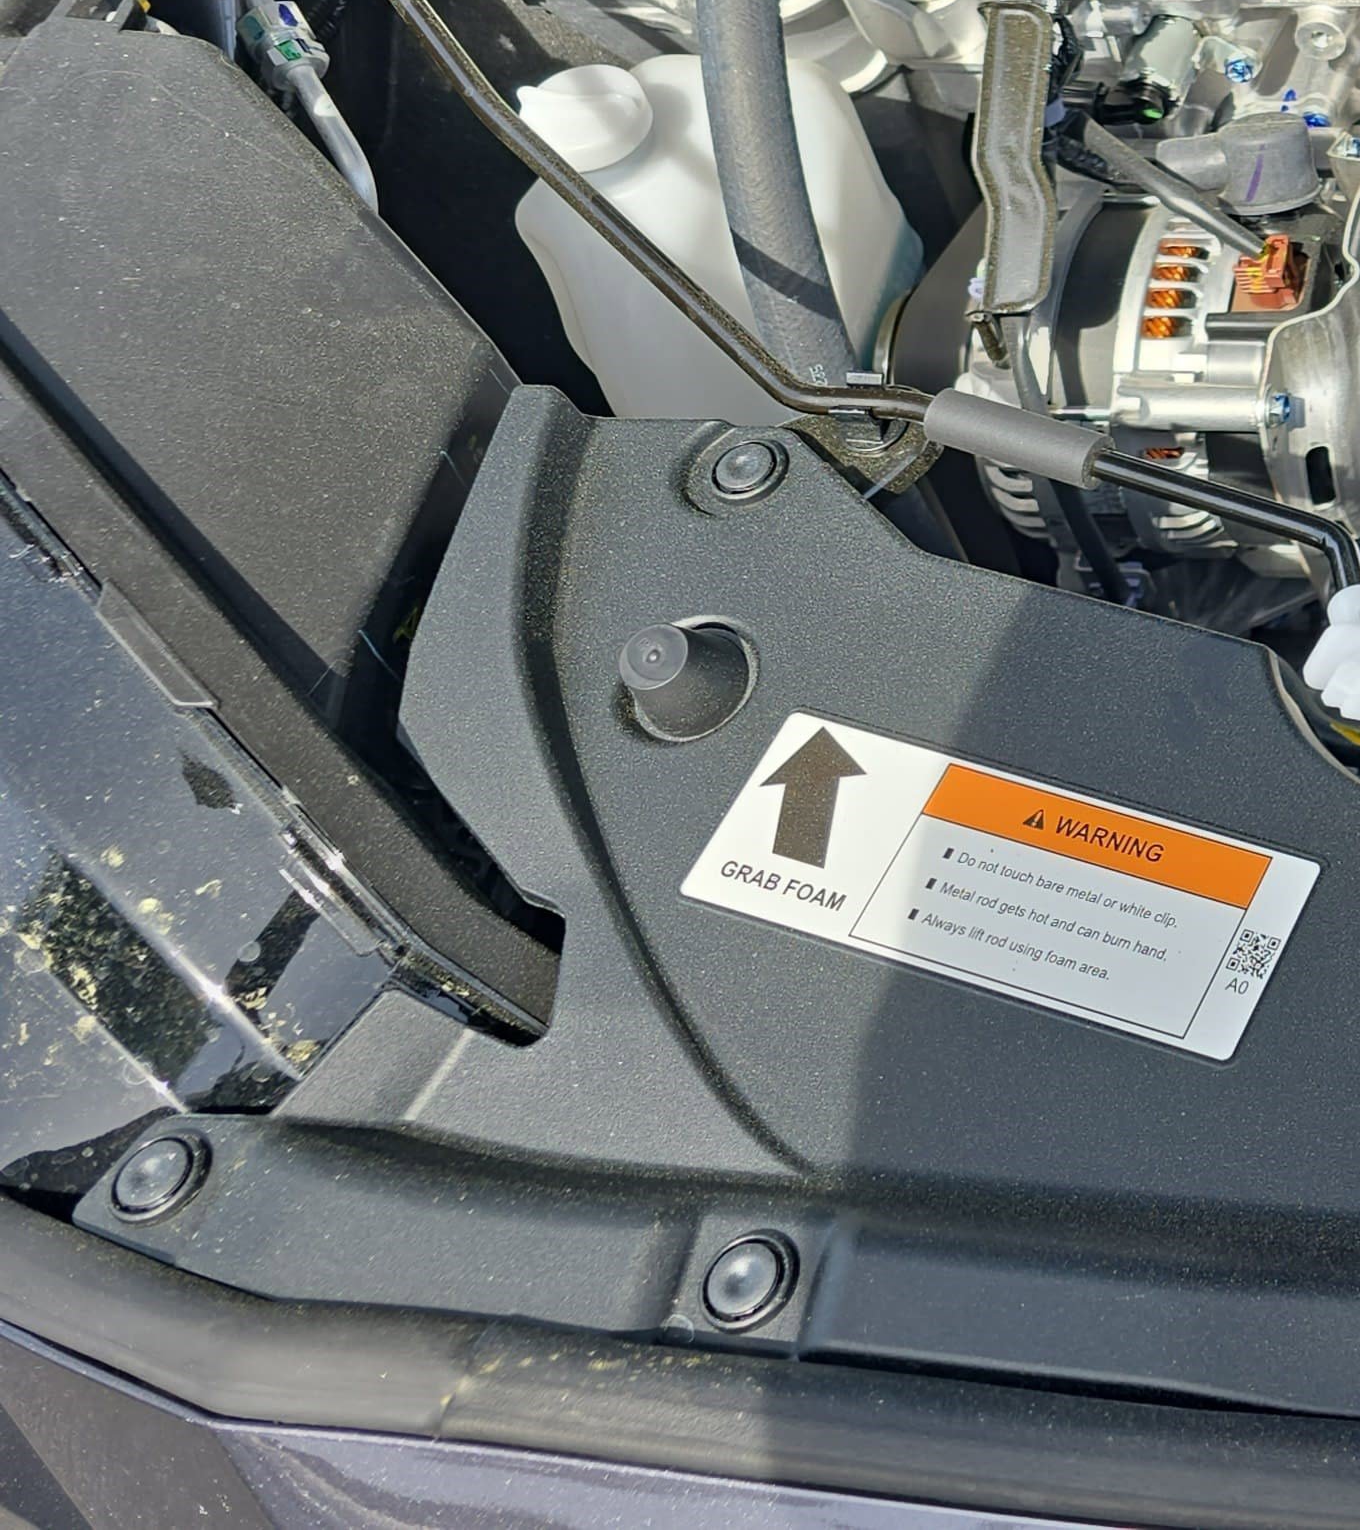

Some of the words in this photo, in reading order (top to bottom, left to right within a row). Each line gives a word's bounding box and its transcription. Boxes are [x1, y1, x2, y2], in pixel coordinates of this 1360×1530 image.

[1056, 815, 1165, 862] WARNING
[721, 860, 781, 891] GRAB
[783, 879, 847, 911] FOAM
[957, 852, 976, 867] Do
[978, 859, 999, 874] not
[1000, 865, 1034, 885] touch
[1036, 875, 1065, 893] bare
[1066, 886, 1103, 904] metal
[1104, 897, 1118, 909] or
[1120, 902, 1152, 919] white
[1154, 912, 1178, 928] clip.
[921, 913, 966, 936] Always
[968, 926, 985, 941] lift
[985, 934, 1009, 948] rod
[1009, 939, 1043, 961] using
[1044, 950, 1077, 970] foam
[1079, 964, 1110, 980] area.
[940, 882, 976, 901] Metal
[976, 895, 1000, 909] rod
[998, 901, 1027, 917] gets
[1028, 909, 1050, 924] hot
[1050, 919, 1076, 933] and
[1077, 926, 1101, 940] can
[1103, 931, 1132, 949] burn
[1132, 941, 1167, 961] hand.
[1225, 977, 1250, 995] A0
